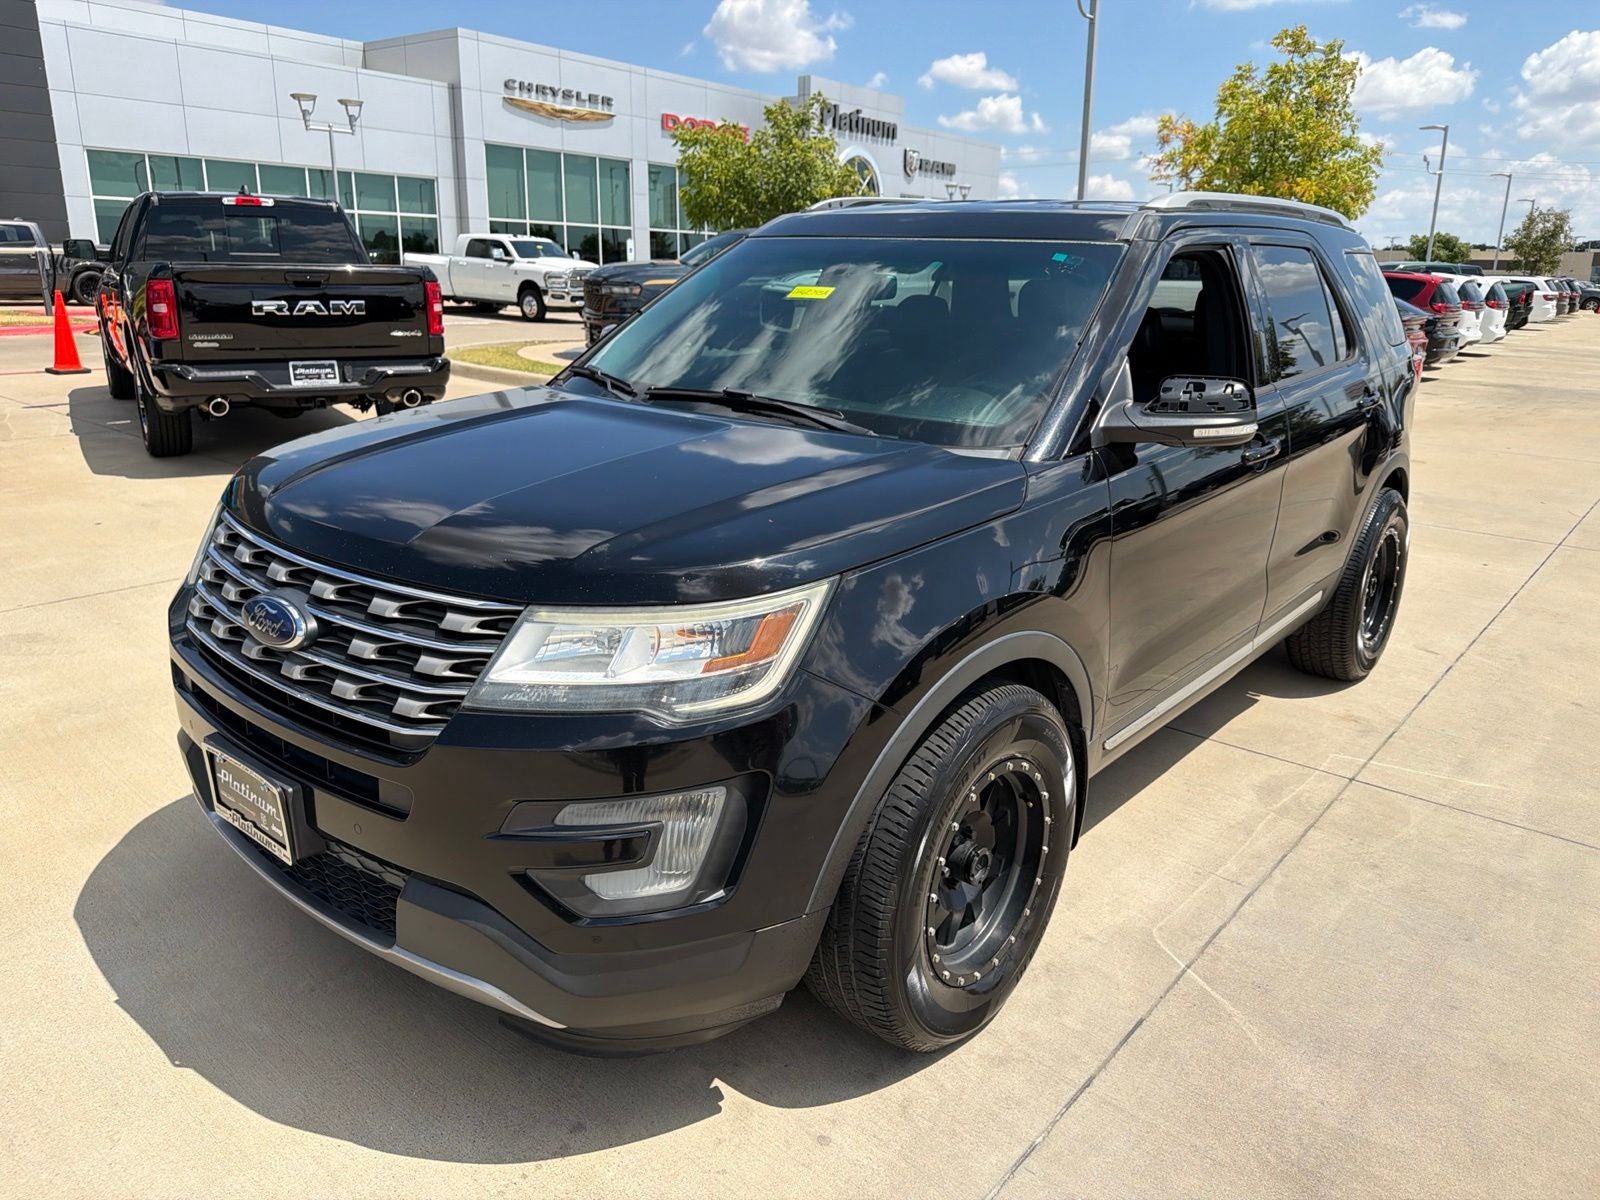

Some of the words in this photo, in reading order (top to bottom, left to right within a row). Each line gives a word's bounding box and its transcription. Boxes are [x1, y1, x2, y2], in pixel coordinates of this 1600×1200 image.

[503, 78, 615, 107] CHRYSLER
[661, 113, 750, 145] DODE
[820, 102, 898, 141] Platinum
[919, 158, 957, 176] RAM
[251, 300, 367, 316] RAM
[248, 602, 285, 638] Ford
[216, 769, 281, 822] Platinum
